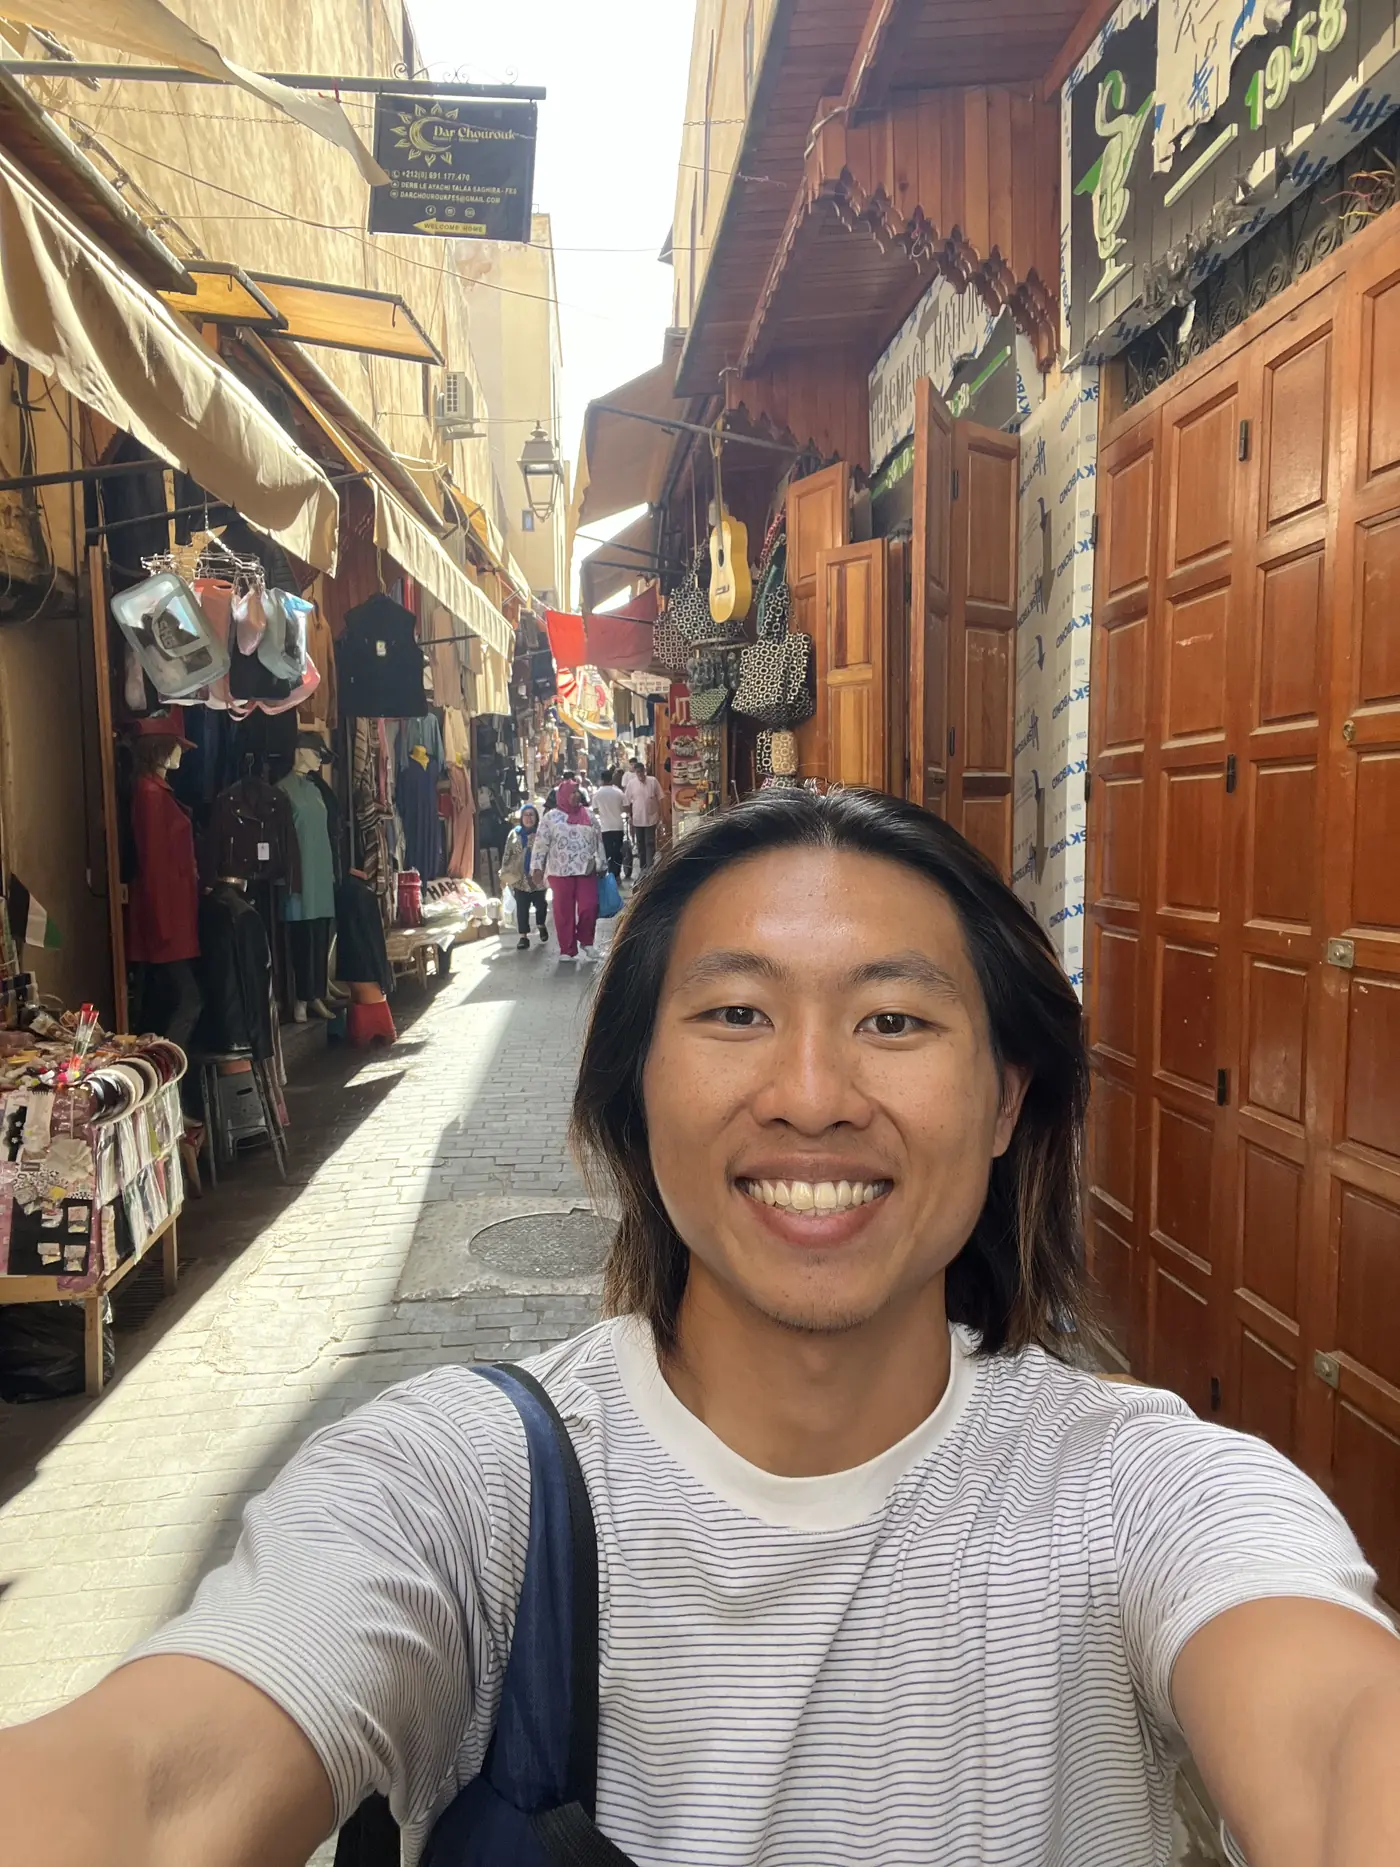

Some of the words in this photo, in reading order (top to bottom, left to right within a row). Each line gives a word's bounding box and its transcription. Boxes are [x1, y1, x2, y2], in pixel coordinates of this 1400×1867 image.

[1245, 0, 1347, 130] 1958
[433, 125, 455, 137] Dar
[457, 125, 516, 140] Chourouk
[423, 222, 459, 231] WELCOME
[463, 224, 484, 233] HOME
